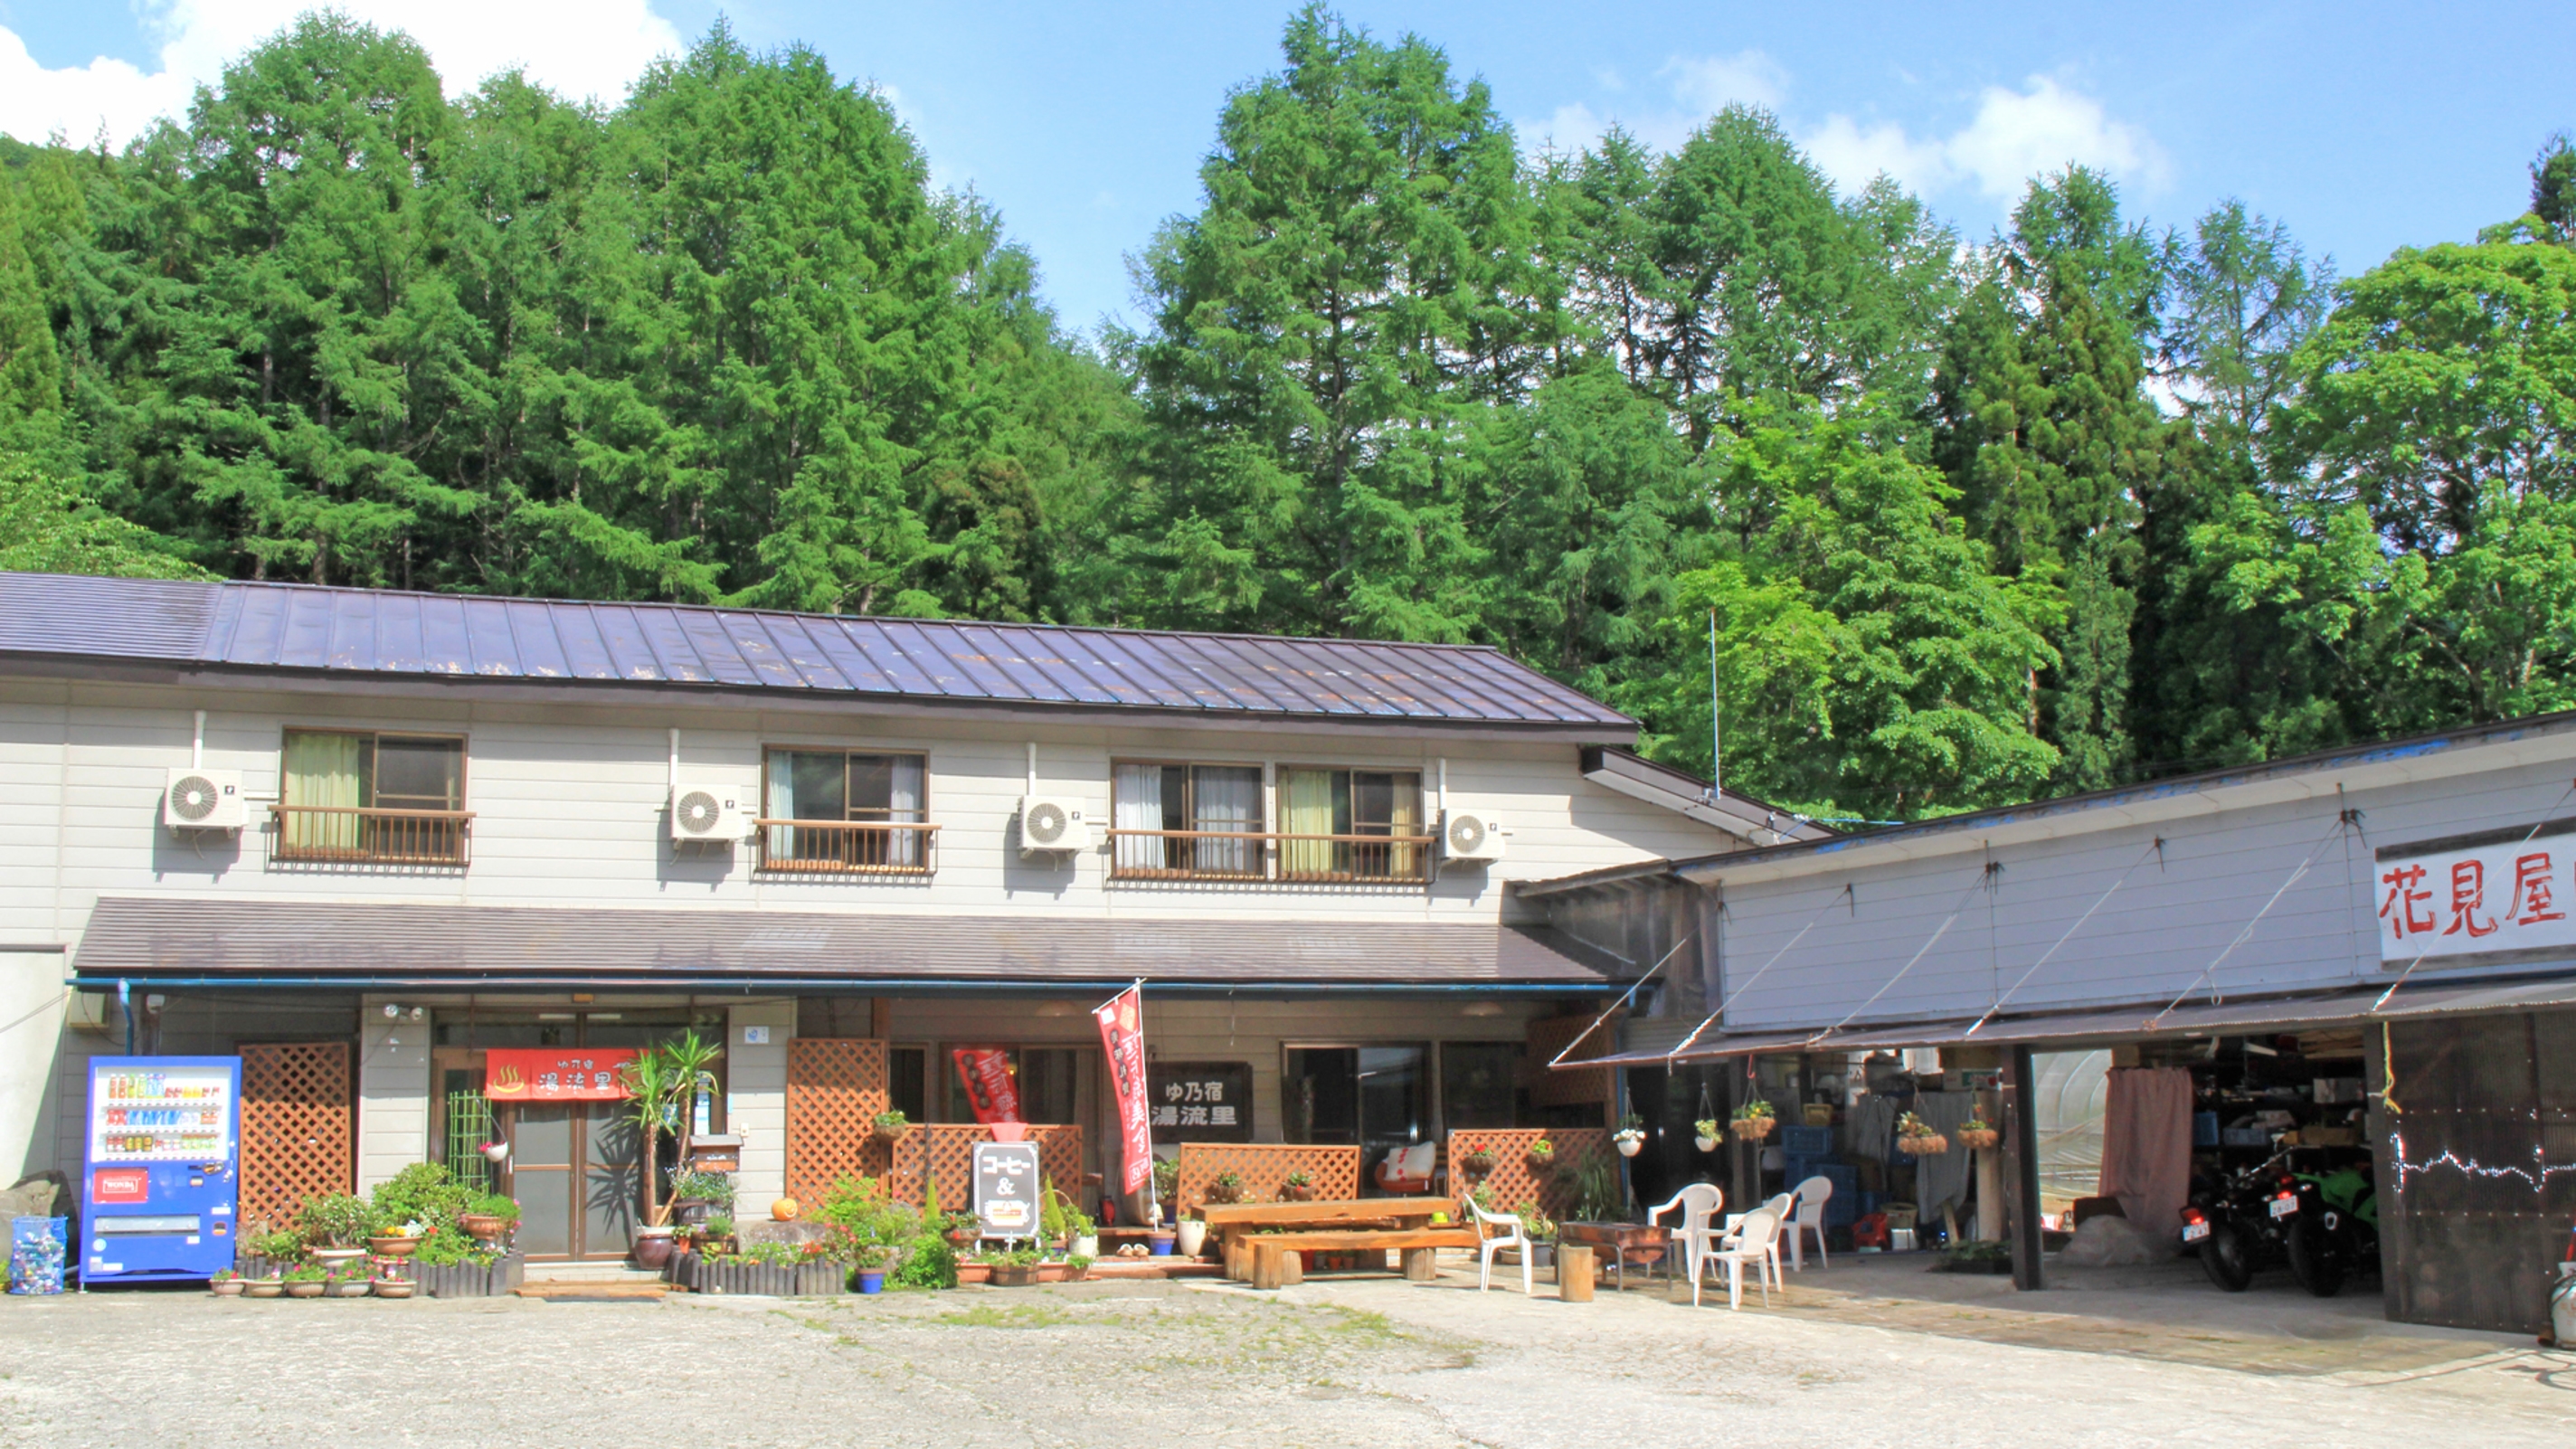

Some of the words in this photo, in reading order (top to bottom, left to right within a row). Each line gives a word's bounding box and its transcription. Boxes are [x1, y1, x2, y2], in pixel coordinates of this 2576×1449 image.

[2379, 852, 2576, 939] 花見屋
[1165, 1081, 1224, 1102] ゆ乃宿
[1151, 1105, 1237, 1126] 湯流里
[982, 1156, 1031, 1175] コーヒー
[106, 1180, 135, 1190] WONDA
[996, 1177, 1016, 1196] &
